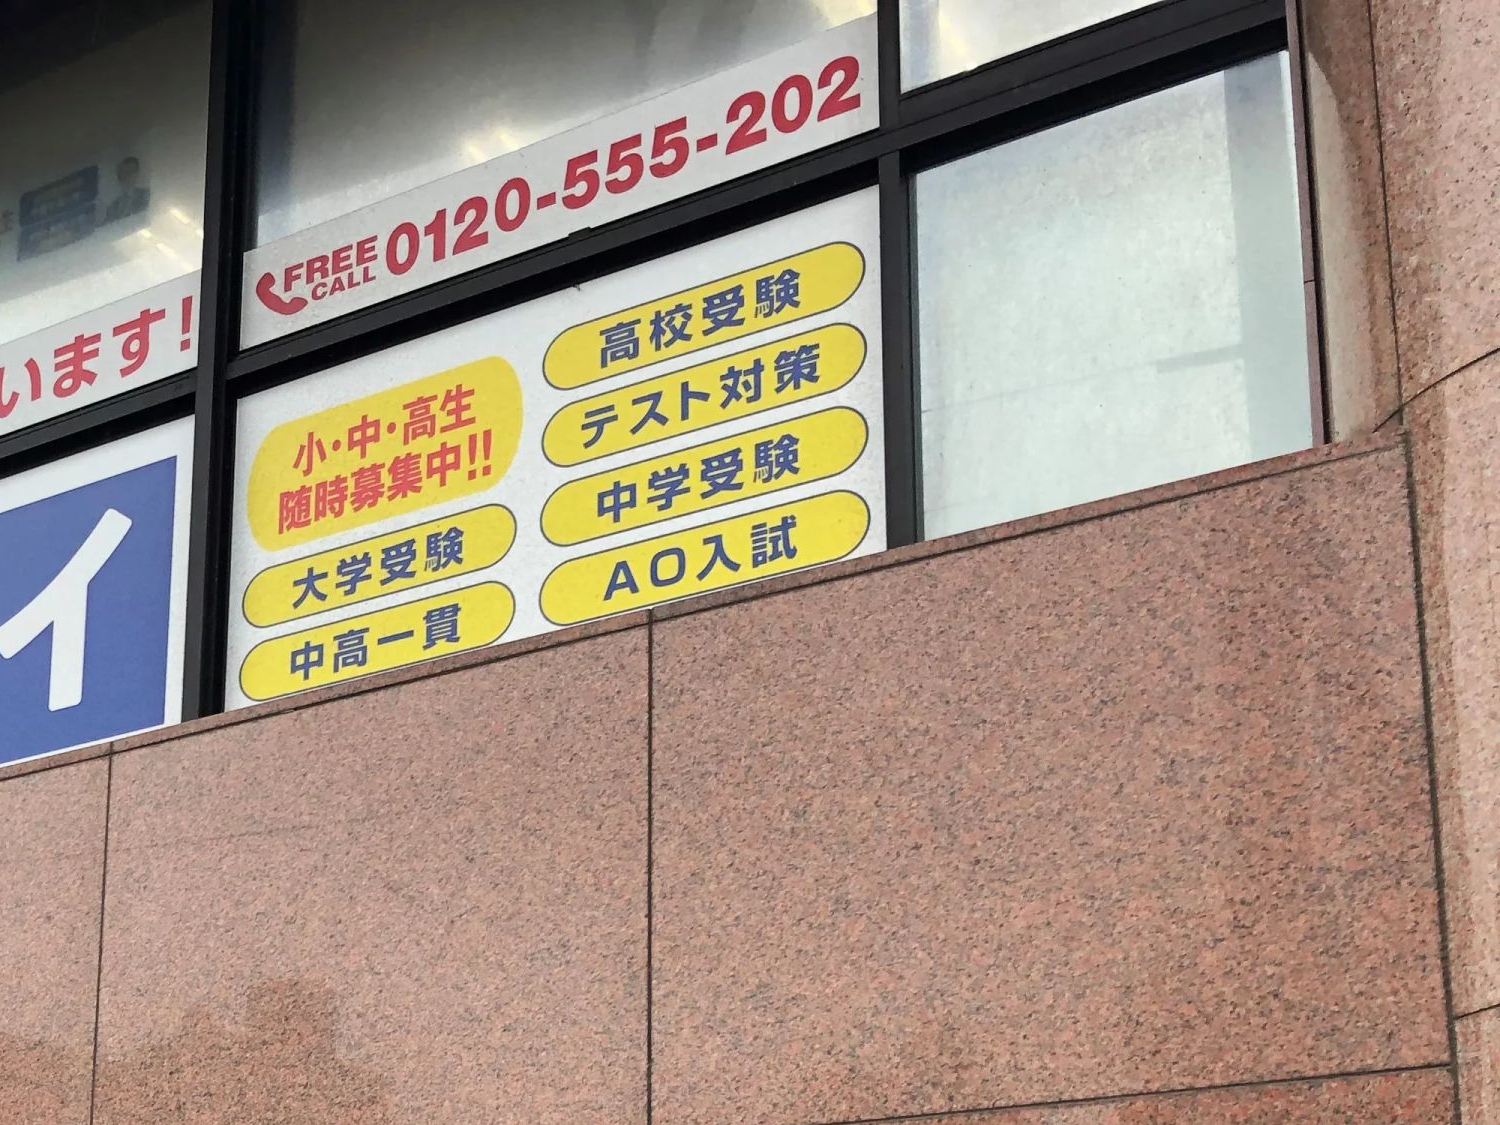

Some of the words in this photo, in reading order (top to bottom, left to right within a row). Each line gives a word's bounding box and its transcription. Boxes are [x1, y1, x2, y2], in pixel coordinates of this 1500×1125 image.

[384, 54, 862, 277] 0120-555-202
[282, 236, 379, 290] FREE
[311, 268, 377, 302] CALL
[600, 269, 800, 368] 高校受験
[293, 384, 477, 476] 小・中・高生
[581, 337, 820, 448] テスト対策
[277, 430, 493, 535] 随時募集中!!
[597, 434, 800, 523] 中学受験
[293, 527, 464, 609] 大学受験
[603, 516, 797, 600] AO入試
[290, 603, 462, 680] 中高一貫
